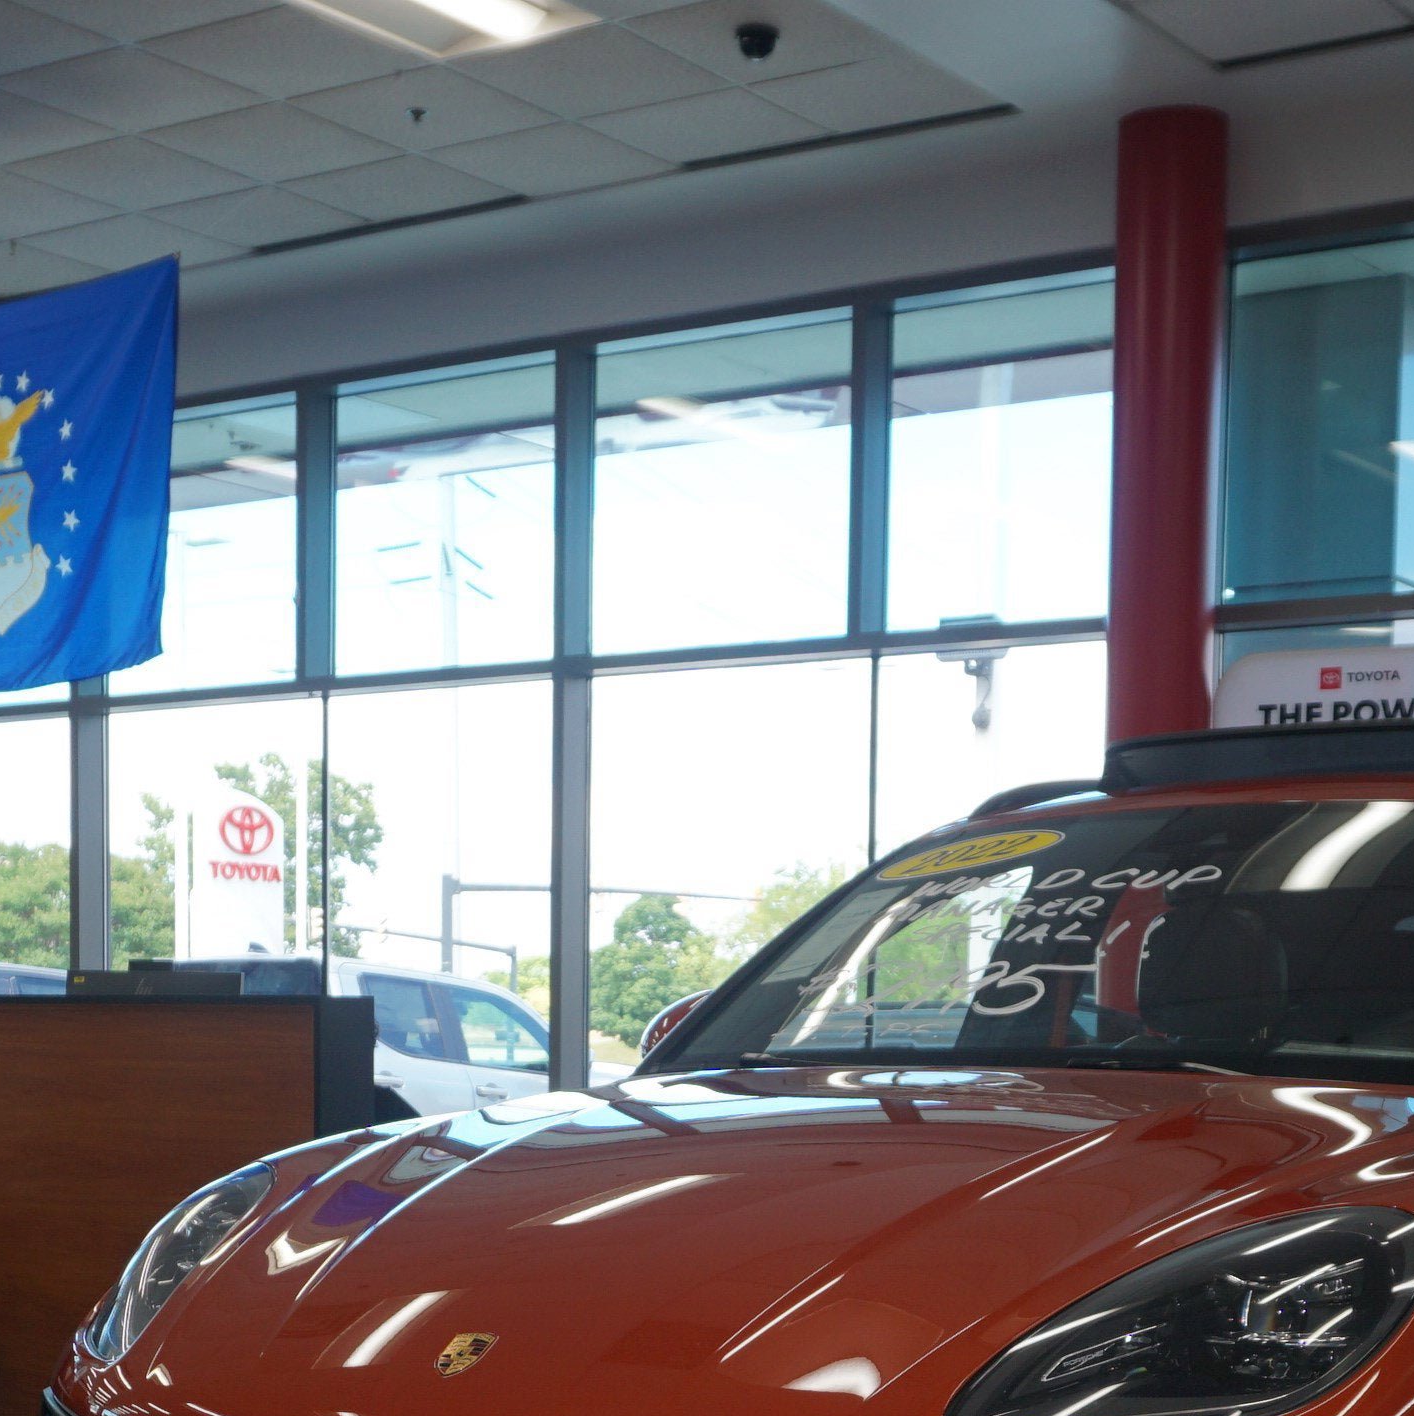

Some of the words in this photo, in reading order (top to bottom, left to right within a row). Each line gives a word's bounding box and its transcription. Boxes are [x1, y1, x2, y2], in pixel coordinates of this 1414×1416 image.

[1347, 669, 1401, 683] TOYOTA
[1258, 702, 1323, 725] THE
[904, 834, 1039, 875] 2022
[209, 860, 282, 883] TOYOTA
[912, 867, 1086, 900] WORLD
[1091, 864, 1223, 891] CUP
